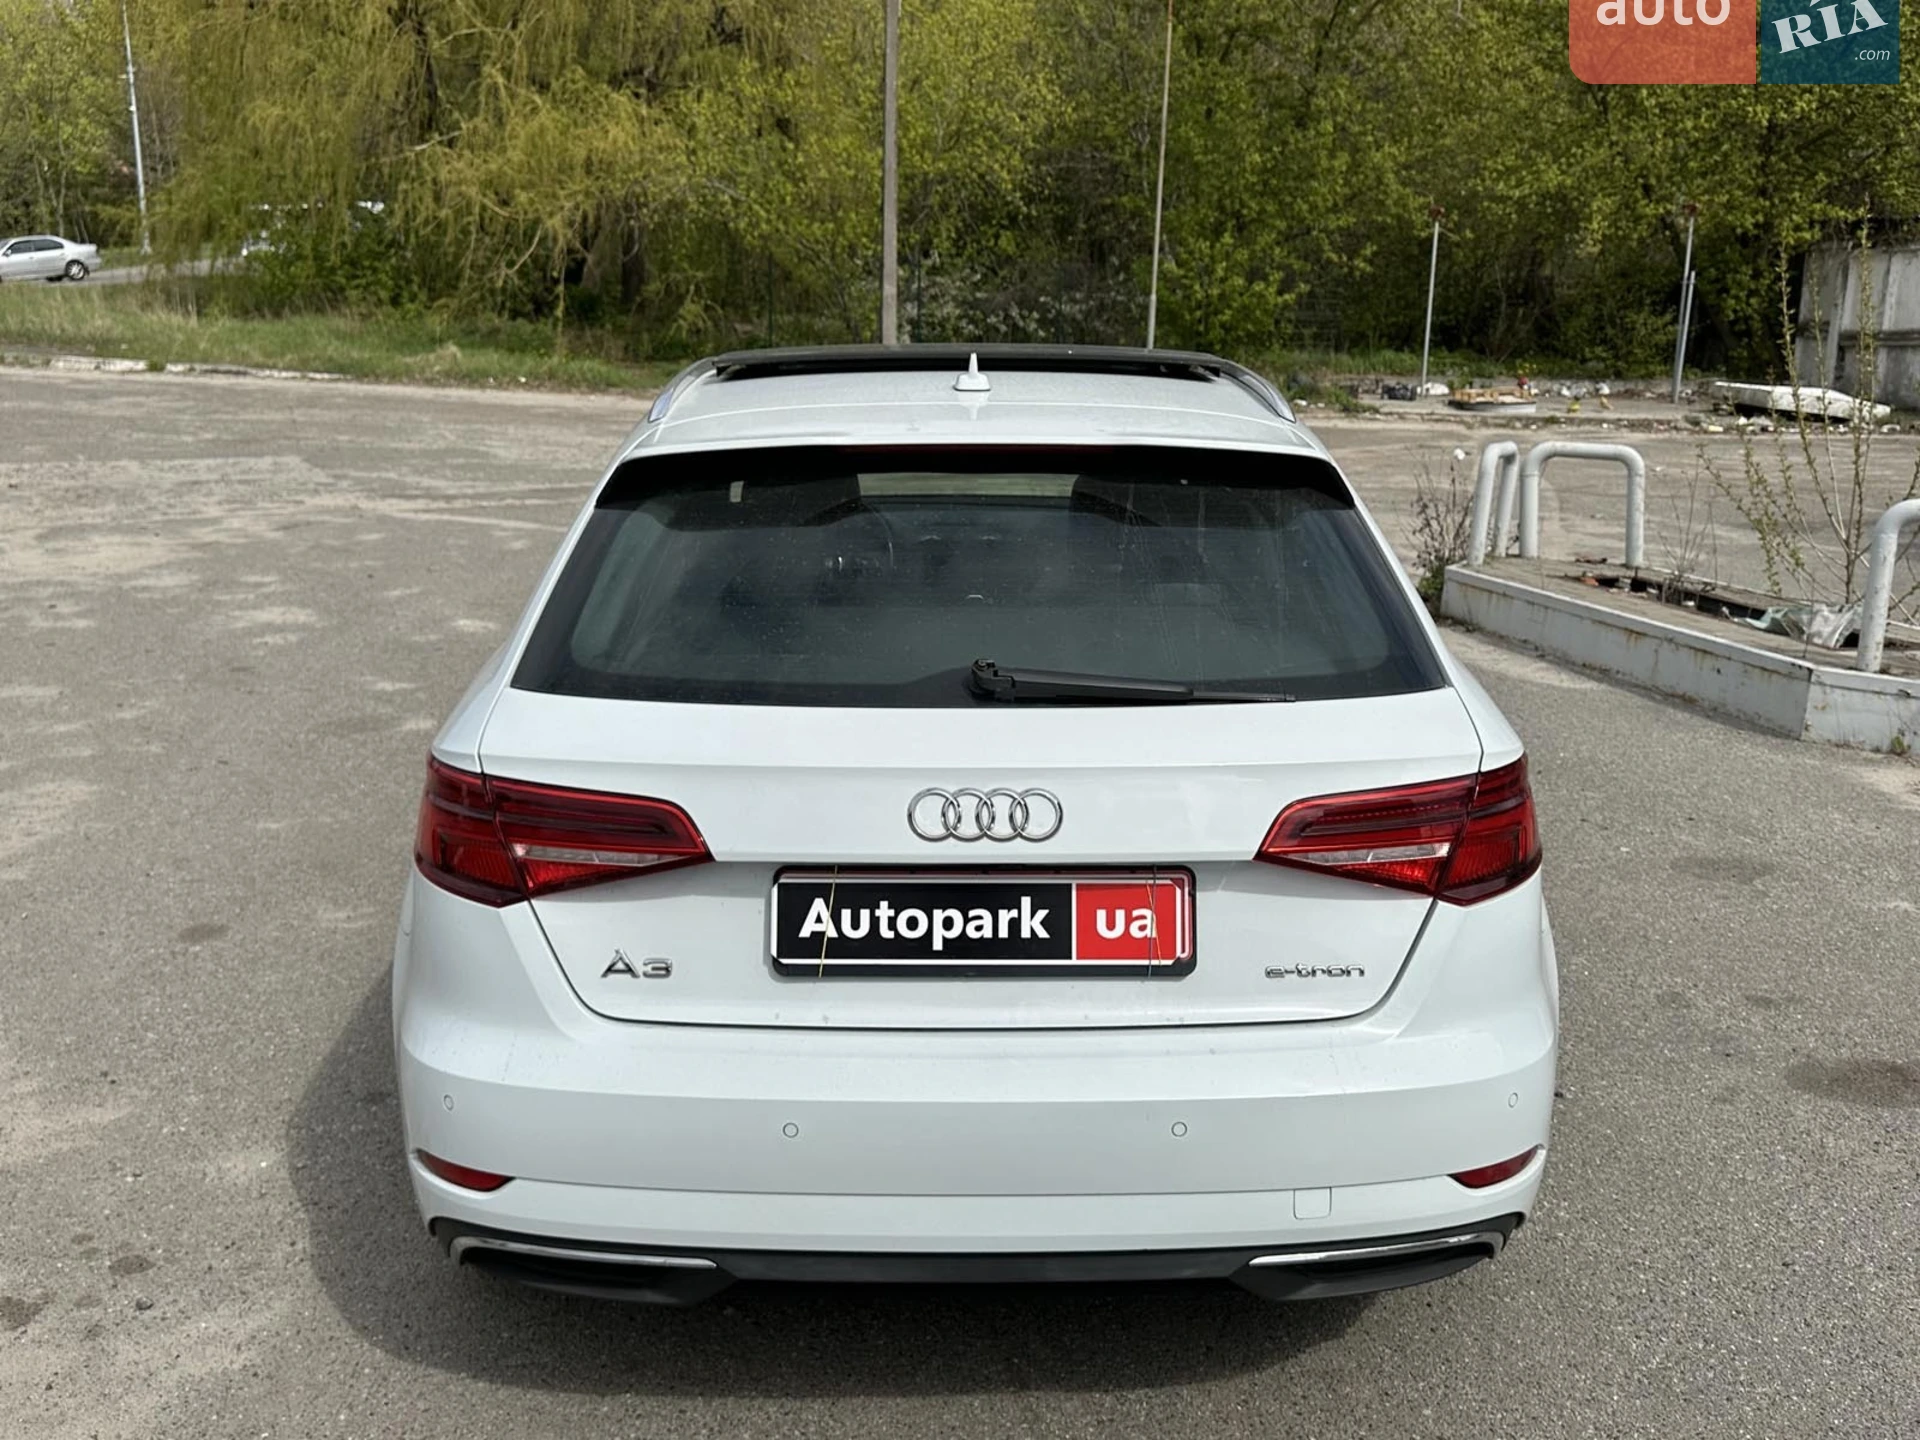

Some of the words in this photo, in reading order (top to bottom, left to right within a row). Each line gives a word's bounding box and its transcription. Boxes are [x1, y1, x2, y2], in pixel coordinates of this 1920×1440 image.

[799, 896, 1050, 950] Autopark
[1096, 908, 1158, 939] ua
[600, 949, 672, 979] A3
[1265, 963, 1365, 979] e-tron
